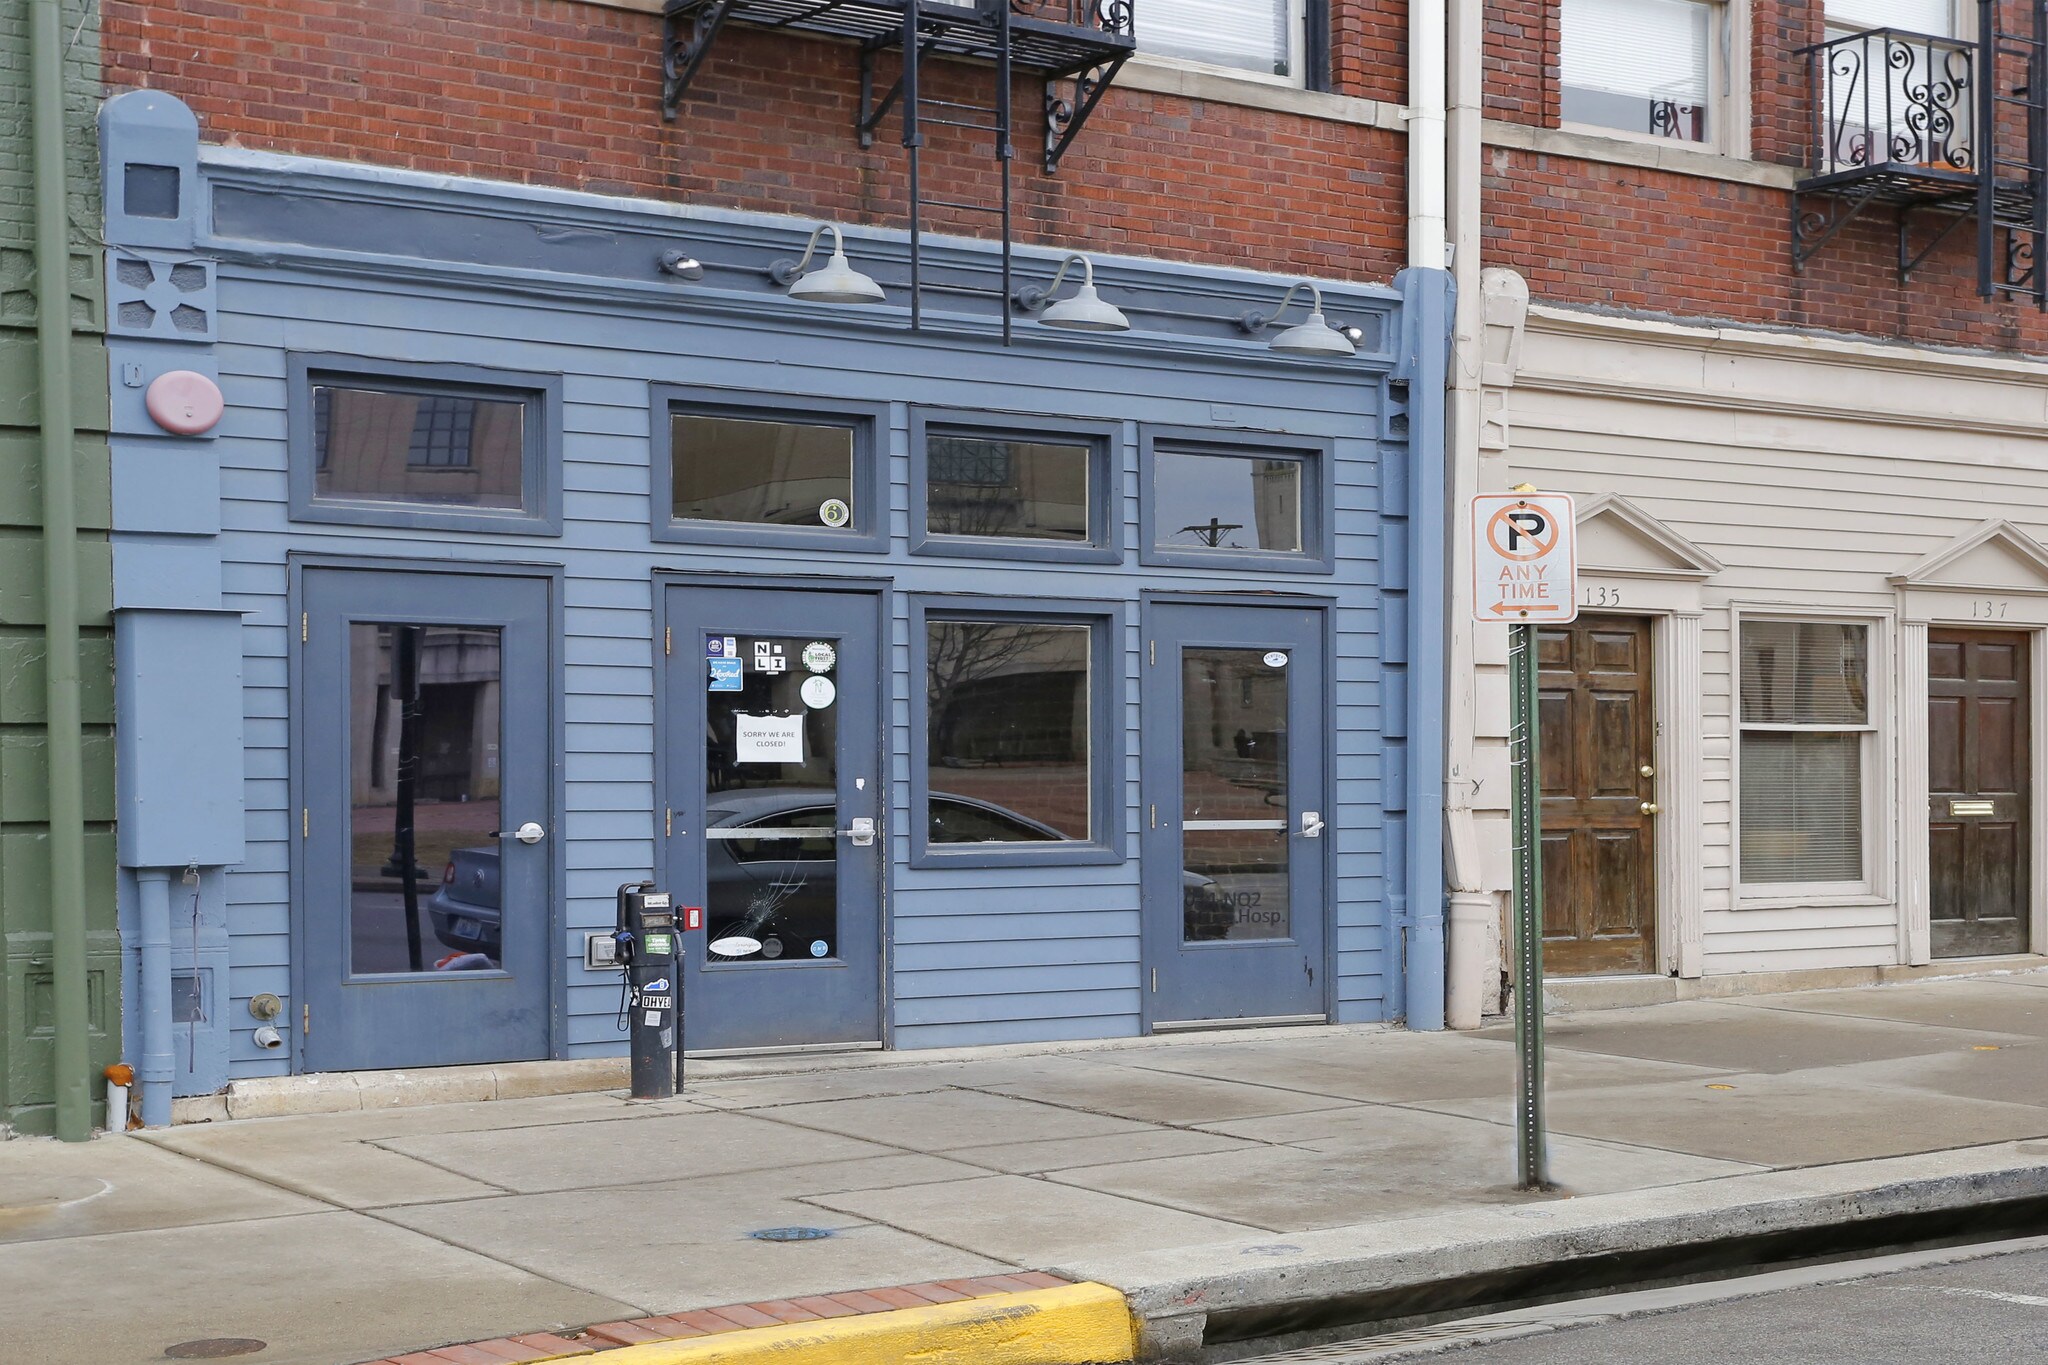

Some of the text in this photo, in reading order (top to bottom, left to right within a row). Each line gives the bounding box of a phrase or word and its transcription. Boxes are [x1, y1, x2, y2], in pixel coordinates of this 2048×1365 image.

[1498, 564, 1548, 581] ANY
[1498, 583, 1550, 599] TIME
[1586, 587, 1620, 607] 135
[1972, 601, 2008, 618] 137
[756, 740, 786, 748] CLOSED!
